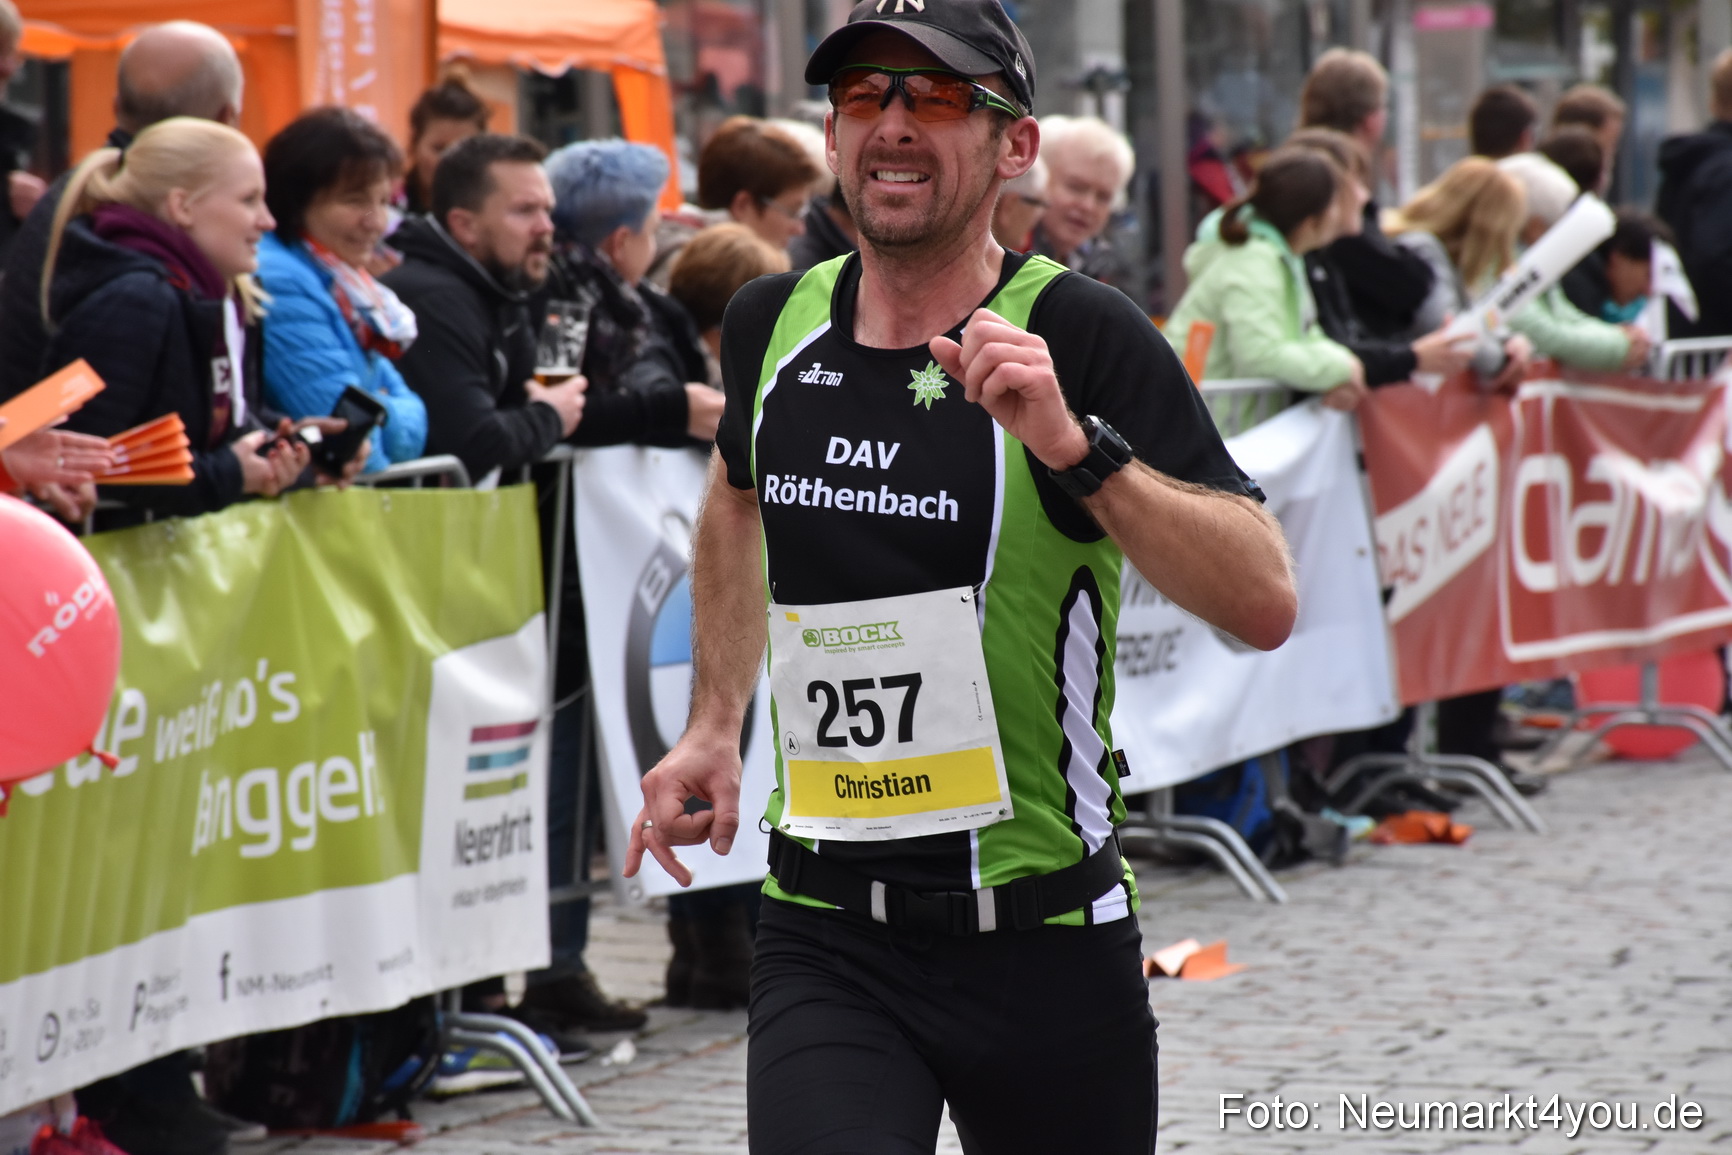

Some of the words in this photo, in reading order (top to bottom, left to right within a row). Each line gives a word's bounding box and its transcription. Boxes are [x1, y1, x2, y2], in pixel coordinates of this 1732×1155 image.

[825, 436, 900, 470] DAV
[764, 474, 959, 522] Röthenbach
[821, 620, 904, 648] BOCK
[824, 646, 848, 655] inspired
[848, 645, 856, 653] by
[858, 644, 876, 652] smart
[877, 641, 905, 650] concepts
[807, 672, 923, 748] 257
[788, 737, 797, 751] A
[834, 772, 932, 799] Christian
